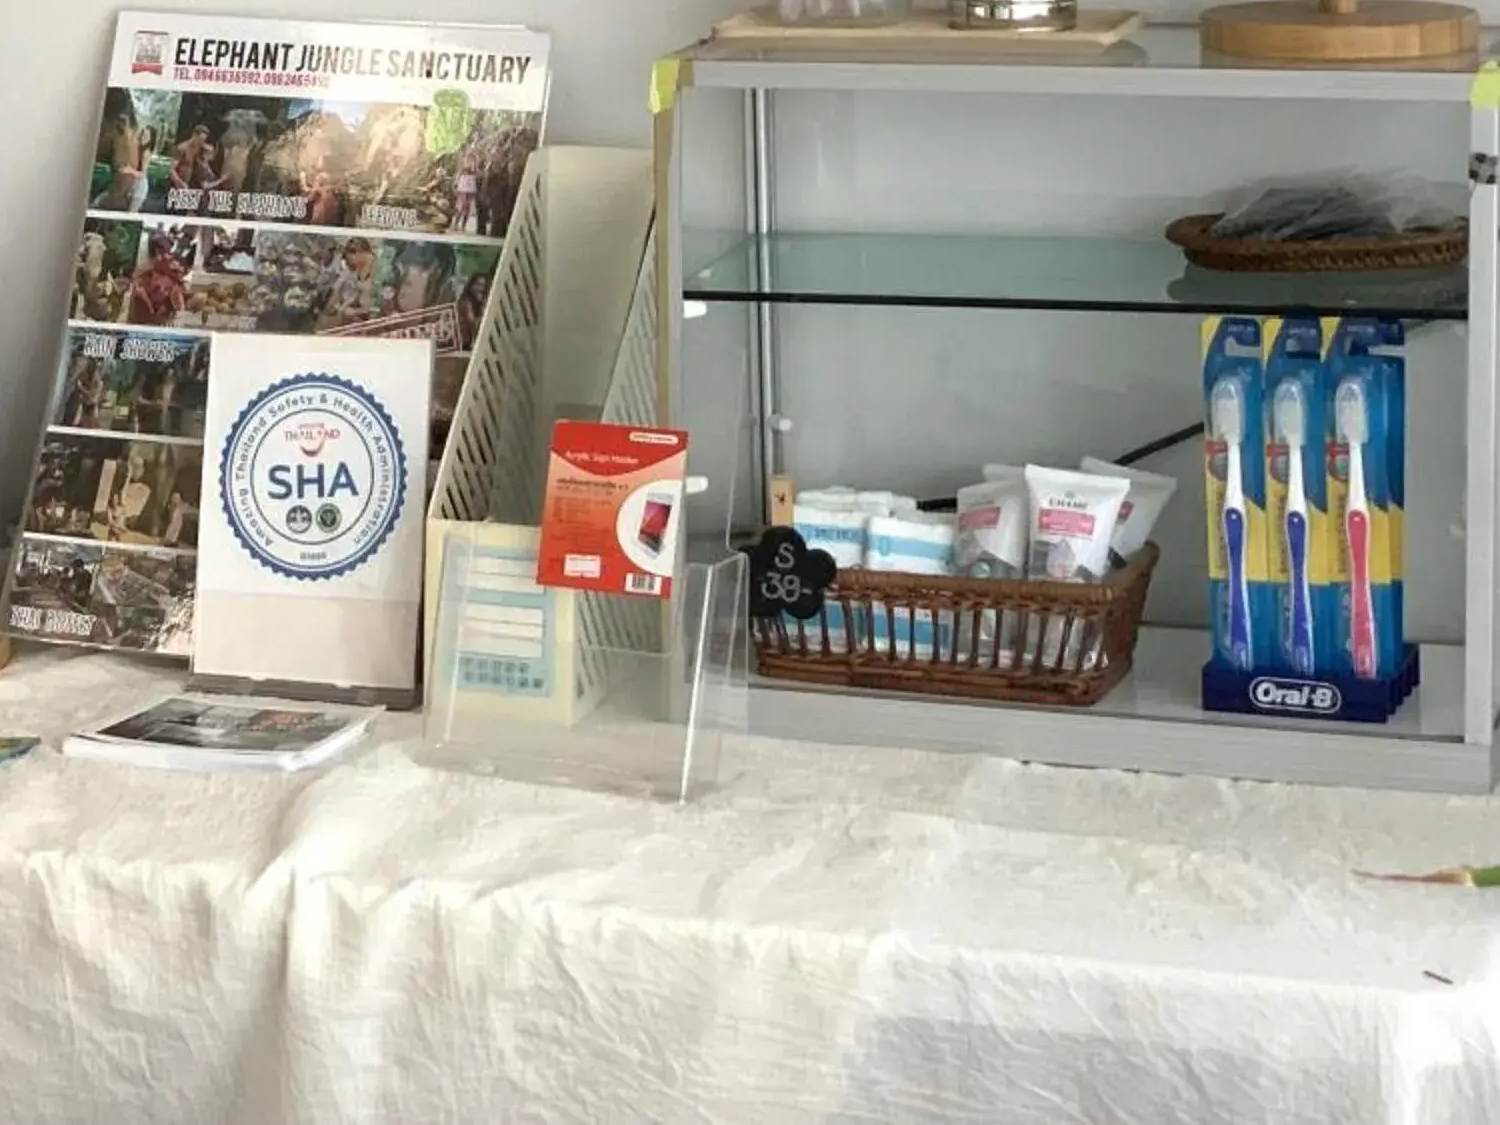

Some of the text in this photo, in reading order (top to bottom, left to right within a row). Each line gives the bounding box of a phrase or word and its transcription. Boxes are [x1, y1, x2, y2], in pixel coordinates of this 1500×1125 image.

[174, 38, 531, 85] ELEPHANT JUNGLE SANCTUARY
[235, 393, 391, 547] Amazing Thailand Safety & Health Administration
[267, 462, 359, 500] SHA
[774, 542, 795, 568] S
[1255, 680, 1334, 710] Oral-B
